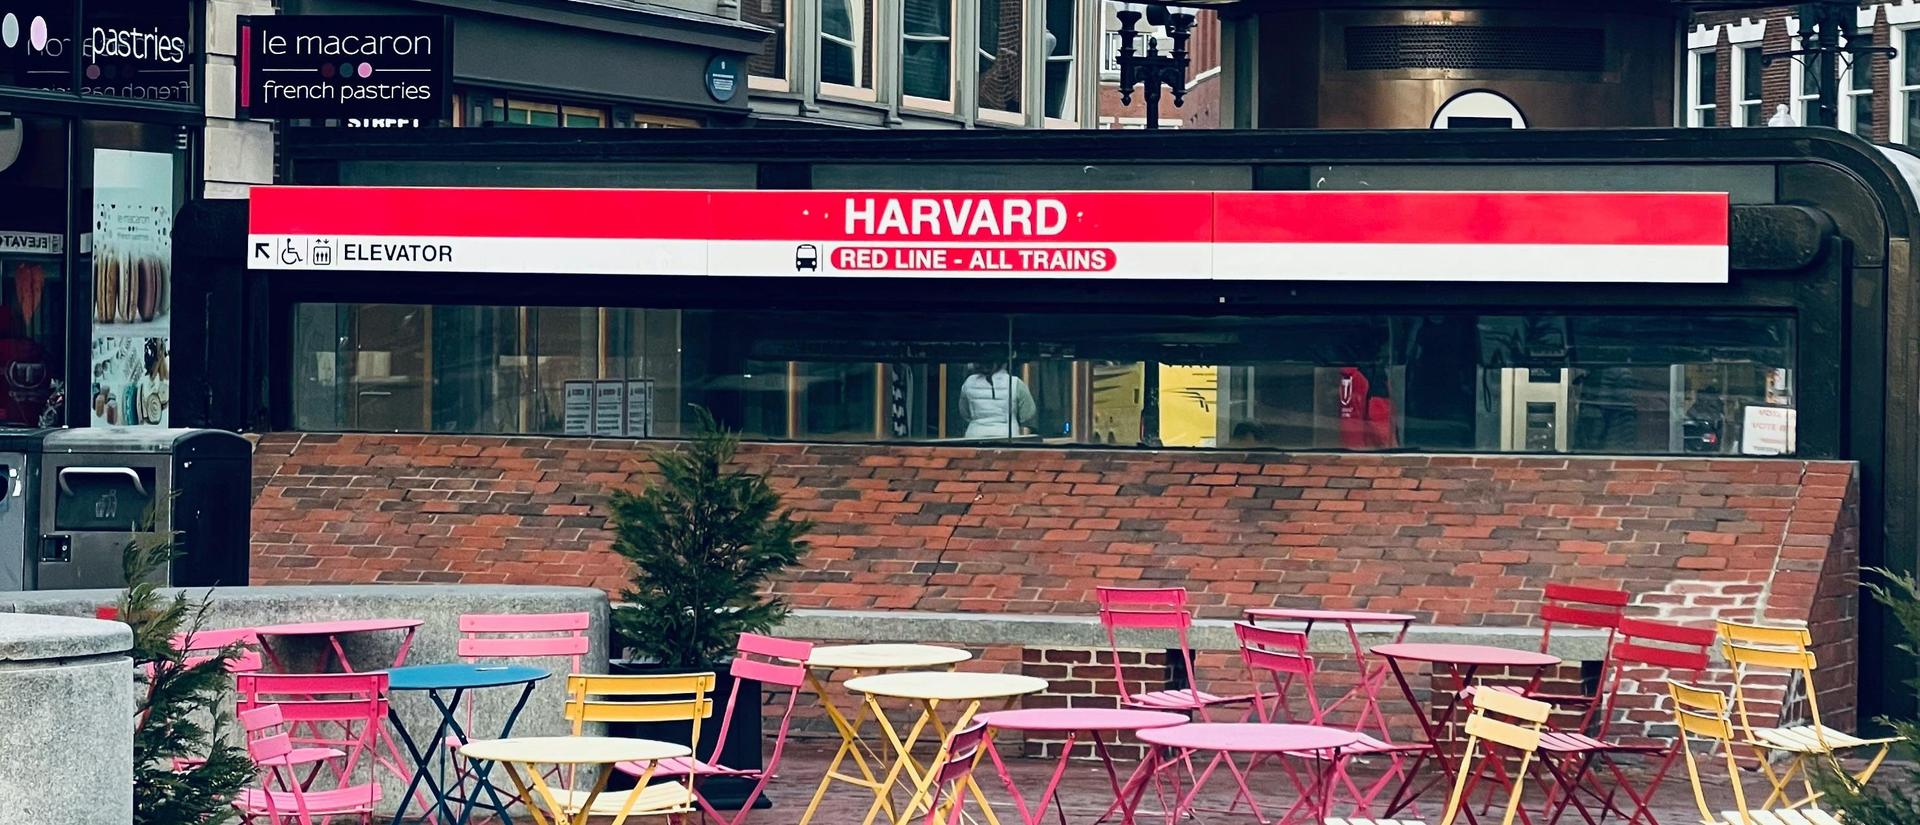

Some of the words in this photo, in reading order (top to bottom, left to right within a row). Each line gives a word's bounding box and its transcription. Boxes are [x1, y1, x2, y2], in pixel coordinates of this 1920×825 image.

[92, 27, 184, 64] pastries
[263, 30, 286, 54] le
[296, 35, 431, 55] macaron
[263, 80, 334, 103] french
[341, 82, 431, 104] pastries
[844, 198, 1068, 236] HARVARD
[344, 244, 453, 262] ELEVATOR
[840, 249, 889, 270] RED
[895, 249, 947, 270] LINE
[969, 249, 1012, 270] ALL
[1018, 250, 1107, 271] TRAINS
